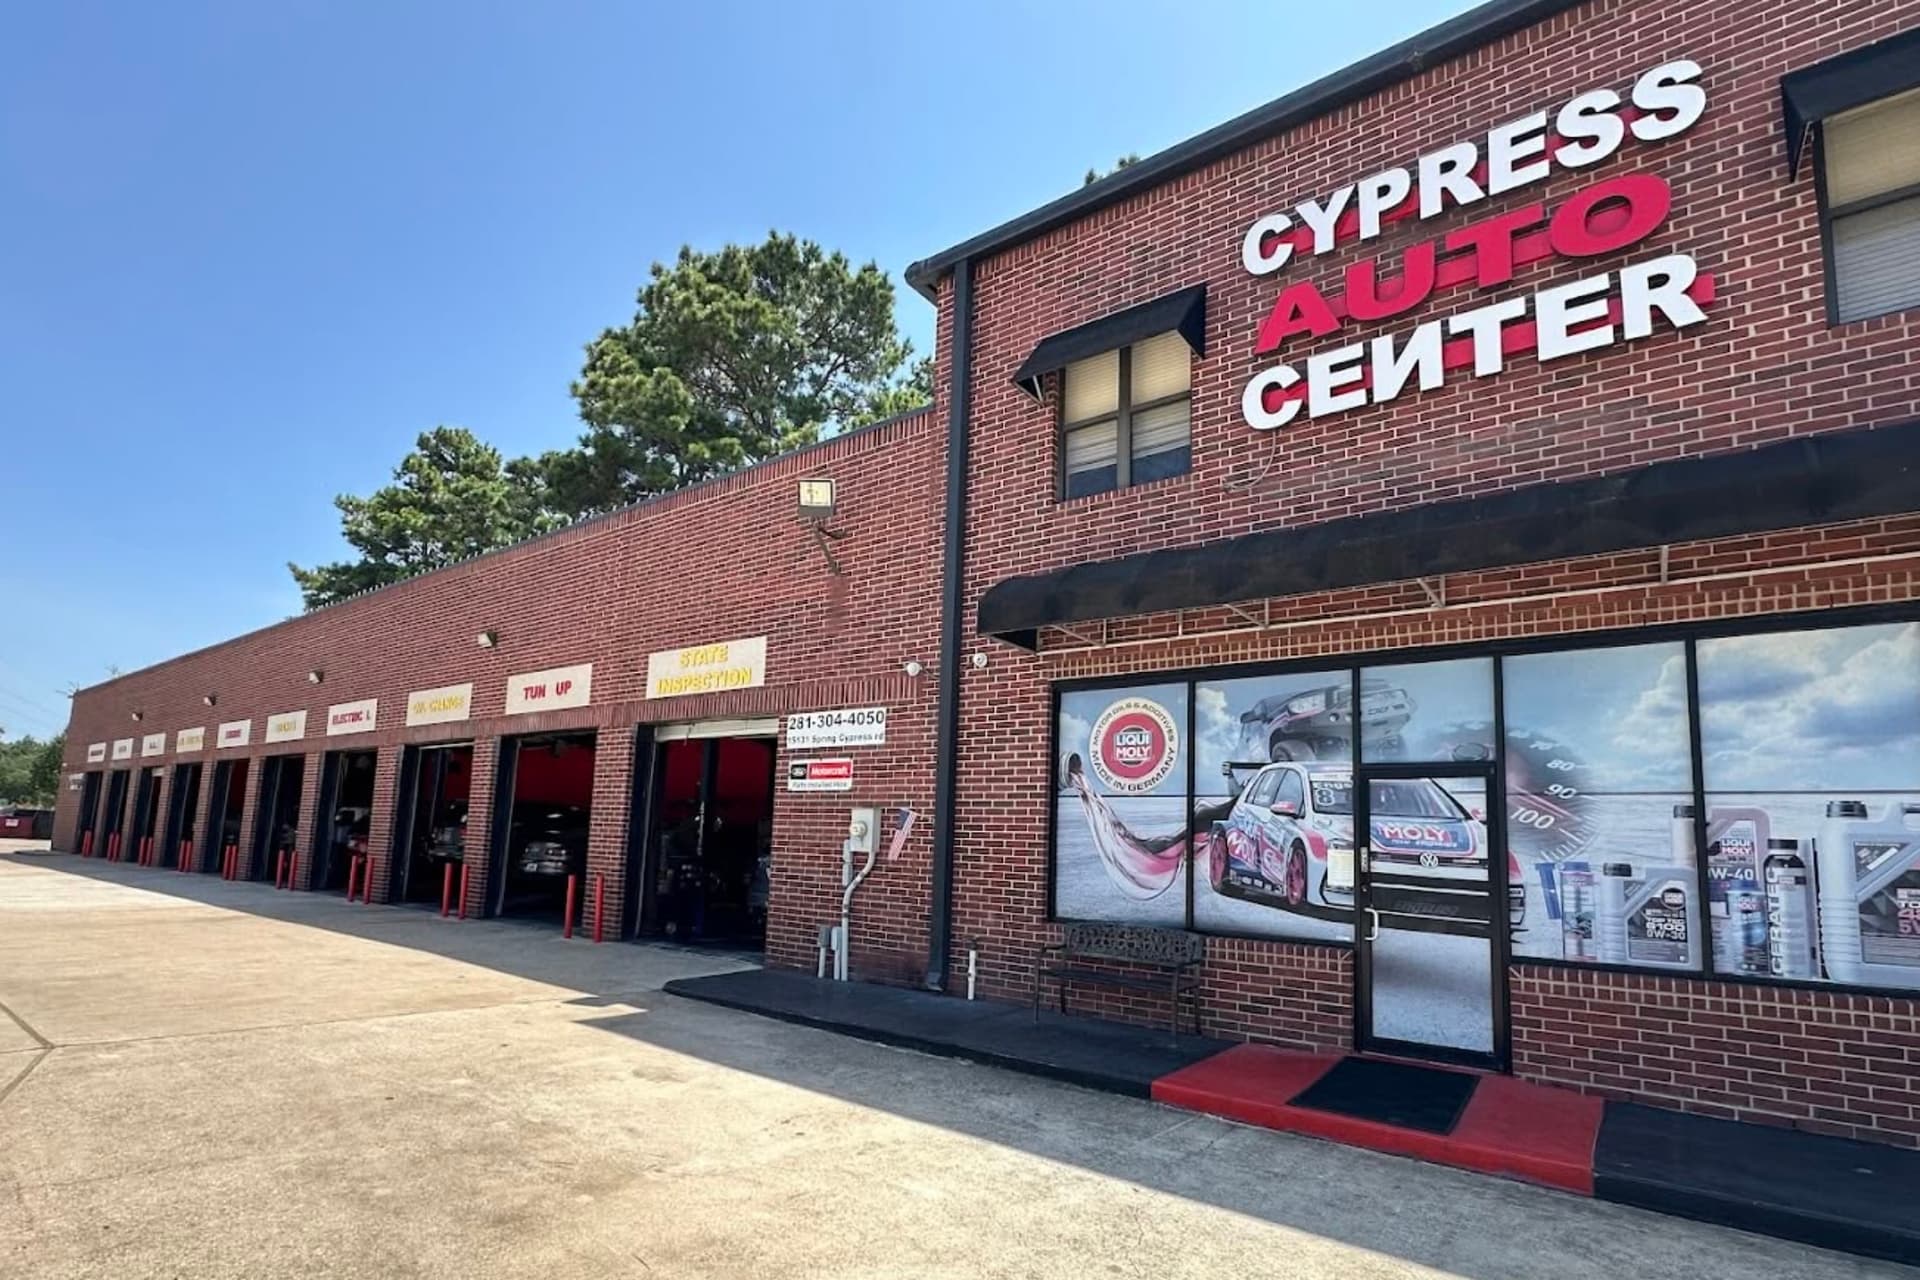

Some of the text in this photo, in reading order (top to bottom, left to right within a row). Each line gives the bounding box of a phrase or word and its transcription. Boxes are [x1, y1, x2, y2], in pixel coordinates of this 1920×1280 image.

[1242, 60, 1707, 275] CYPRESS
[1254, 173, 1672, 355] AUTO
[680, 644, 729, 668] STATE
[523, 680, 573, 700] TUN UP
[656, 668, 753, 694] INSPECTION
[789, 710, 885, 730] 281-304-4050
[1093, 711, 1113, 746] MOTOR
[1142, 703, 1175, 742] ADDITIVES
[812, 735, 836, 744] Spring
[840, 733, 873, 744] Cypress
[1116, 734, 1150, 746] LIQUI
[1116, 746, 1151, 759] MOLY
[811, 765, 848, 777] Motorcraft
[1091, 747, 1175, 792] MADE IN GERMANY
[1546, 759, 1575, 771] 80
[1317, 788, 1335, 806] 8
[1544, 784, 1577, 799] 90
[1510, 807, 1555, 829] 100
[1382, 825, 1450, 842] MOLY
[1721, 838, 1750, 847] LIQUI
[1721, 846, 1752, 855] MOLY
